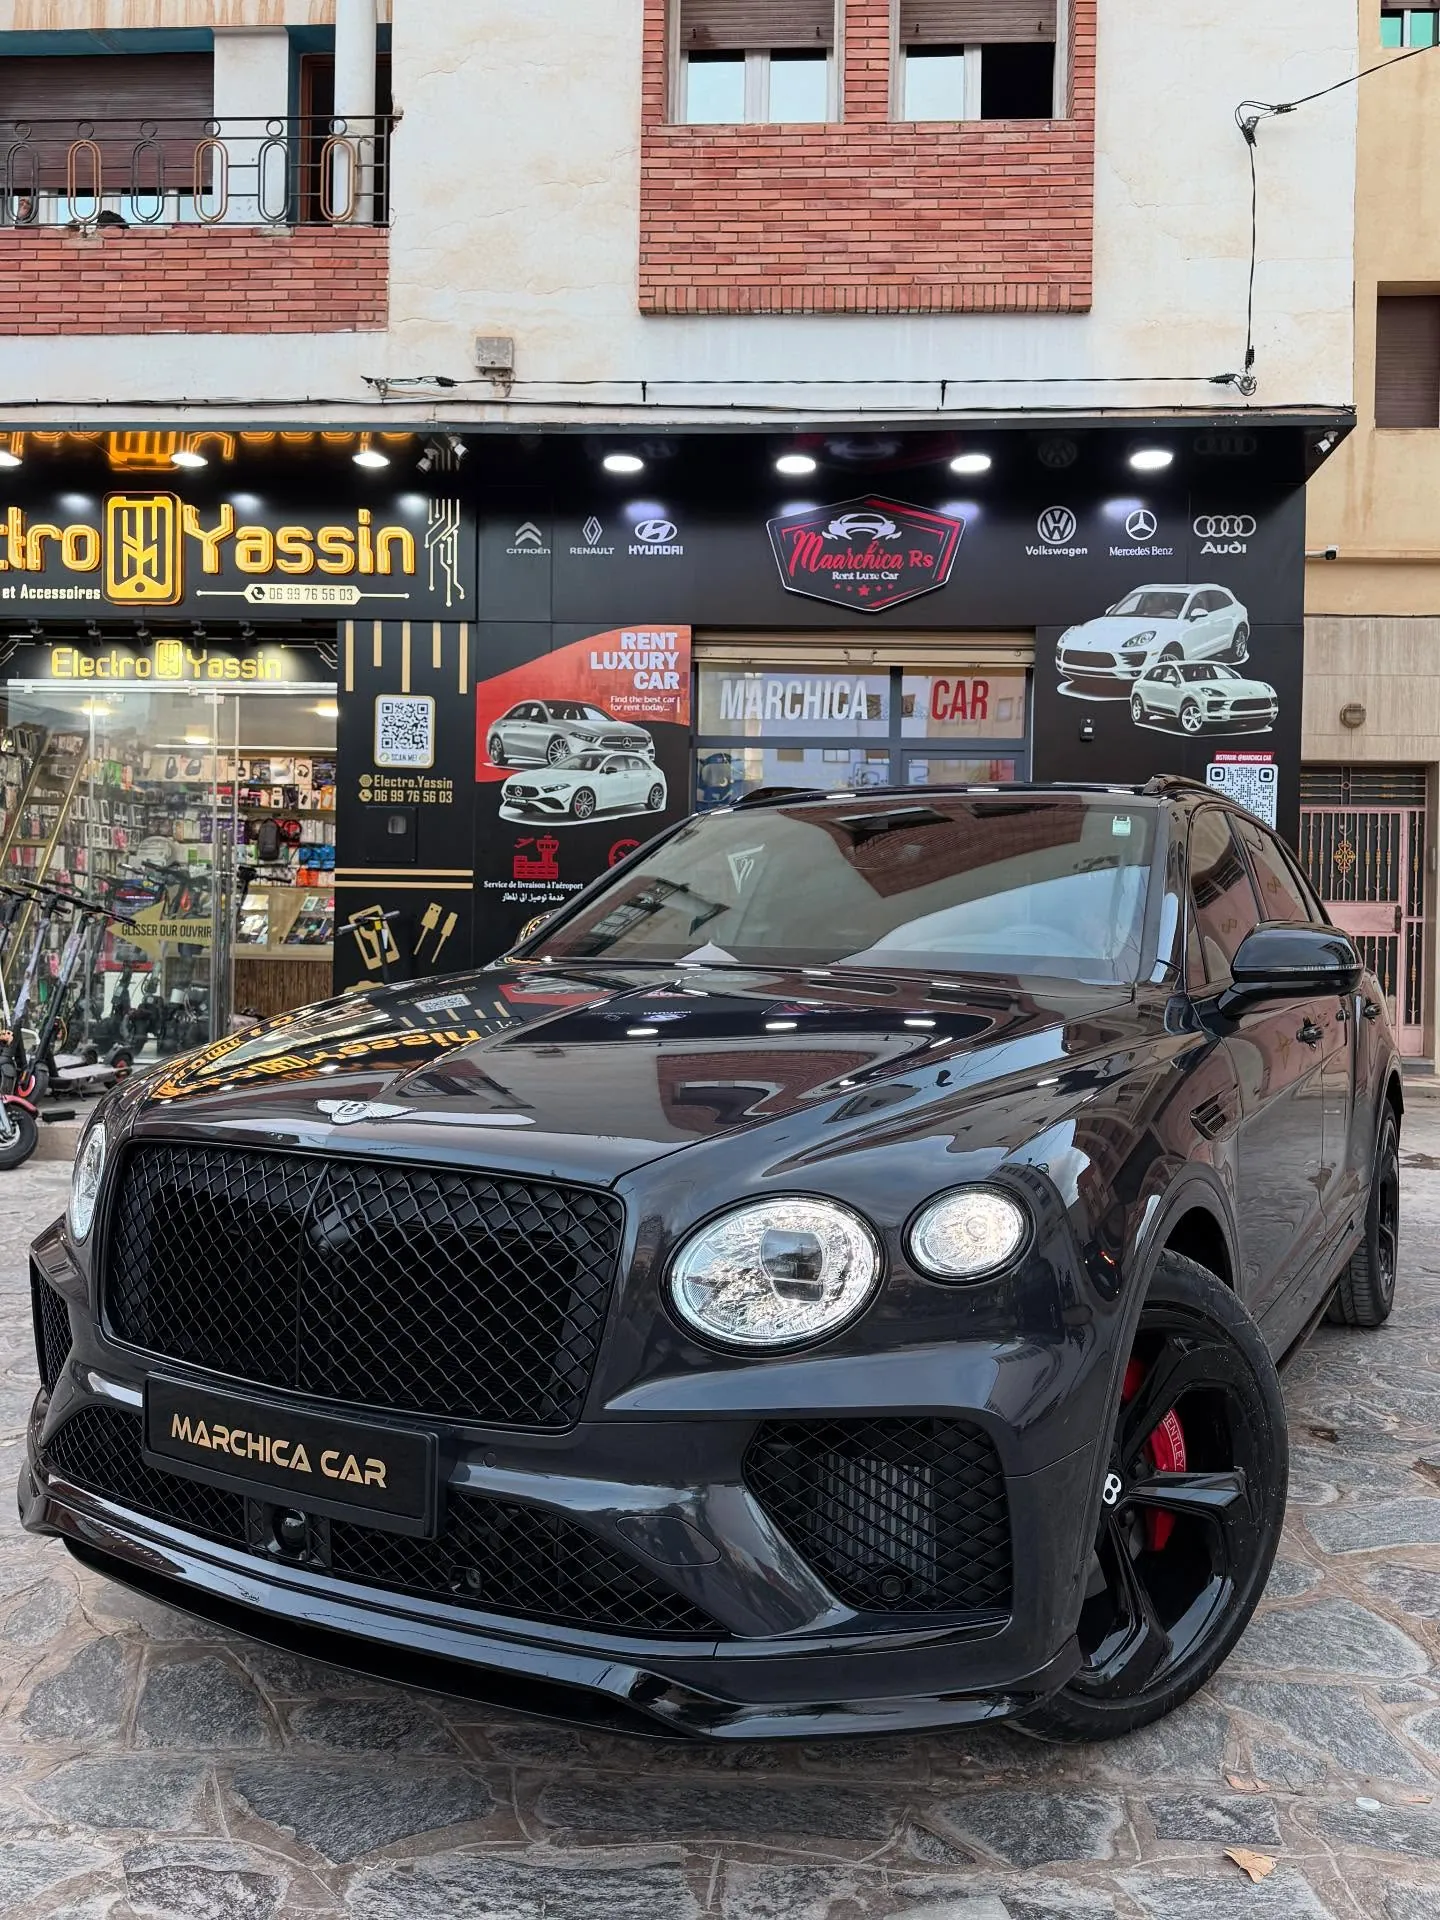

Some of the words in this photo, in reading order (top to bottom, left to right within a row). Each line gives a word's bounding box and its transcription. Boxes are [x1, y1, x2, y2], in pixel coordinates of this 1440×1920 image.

[183, 503, 415, 574] Yassin
[570, 547, 615, 555] RENAULT
[628, 545, 683, 555] HYUNDAI
[788, 529, 904, 577] Maarchica
[908, 550, 934, 567] Rs
[1026, 546, 1088, 556] Volkswagen
[1109, 546, 1151, 556] Mercedes
[1152, 546, 1173, 556] Benz
[1200, 541, 1247, 554] Audi
[832, 571, 854, 580] Rent
[881, 571, 899, 580] Car
[2, 585, 16, 599] et
[20, 583, 100, 600] Accessoires
[269, 588, 283, 600] 06
[304, 588, 318, 601] 76
[322, 588, 335, 601] 56
[339, 588, 353, 601] 03
[621, 632, 677, 649] RENT
[51, 648, 151, 678] Electro
[186, 648, 282, 679] Yassin
[590, 652, 679, 669] LUXURY
[634, 672, 679, 689] CAR
[719, 680, 868, 720] MARCHICA
[931, 680, 989, 720] CAR
[374, 775, 453, 789] Electro.Yassin
[374, 790, 388, 802] 06
[390, 790, 404, 802] 99
[406, 790, 420, 802] 76
[422, 791, 436, 803] 56
[439, 791, 453, 803] 03
[122, 924, 158, 936] GLISSER
[171, 1413, 312, 1473] MARCHICA
[320, 1450, 387, 1489] CAR
